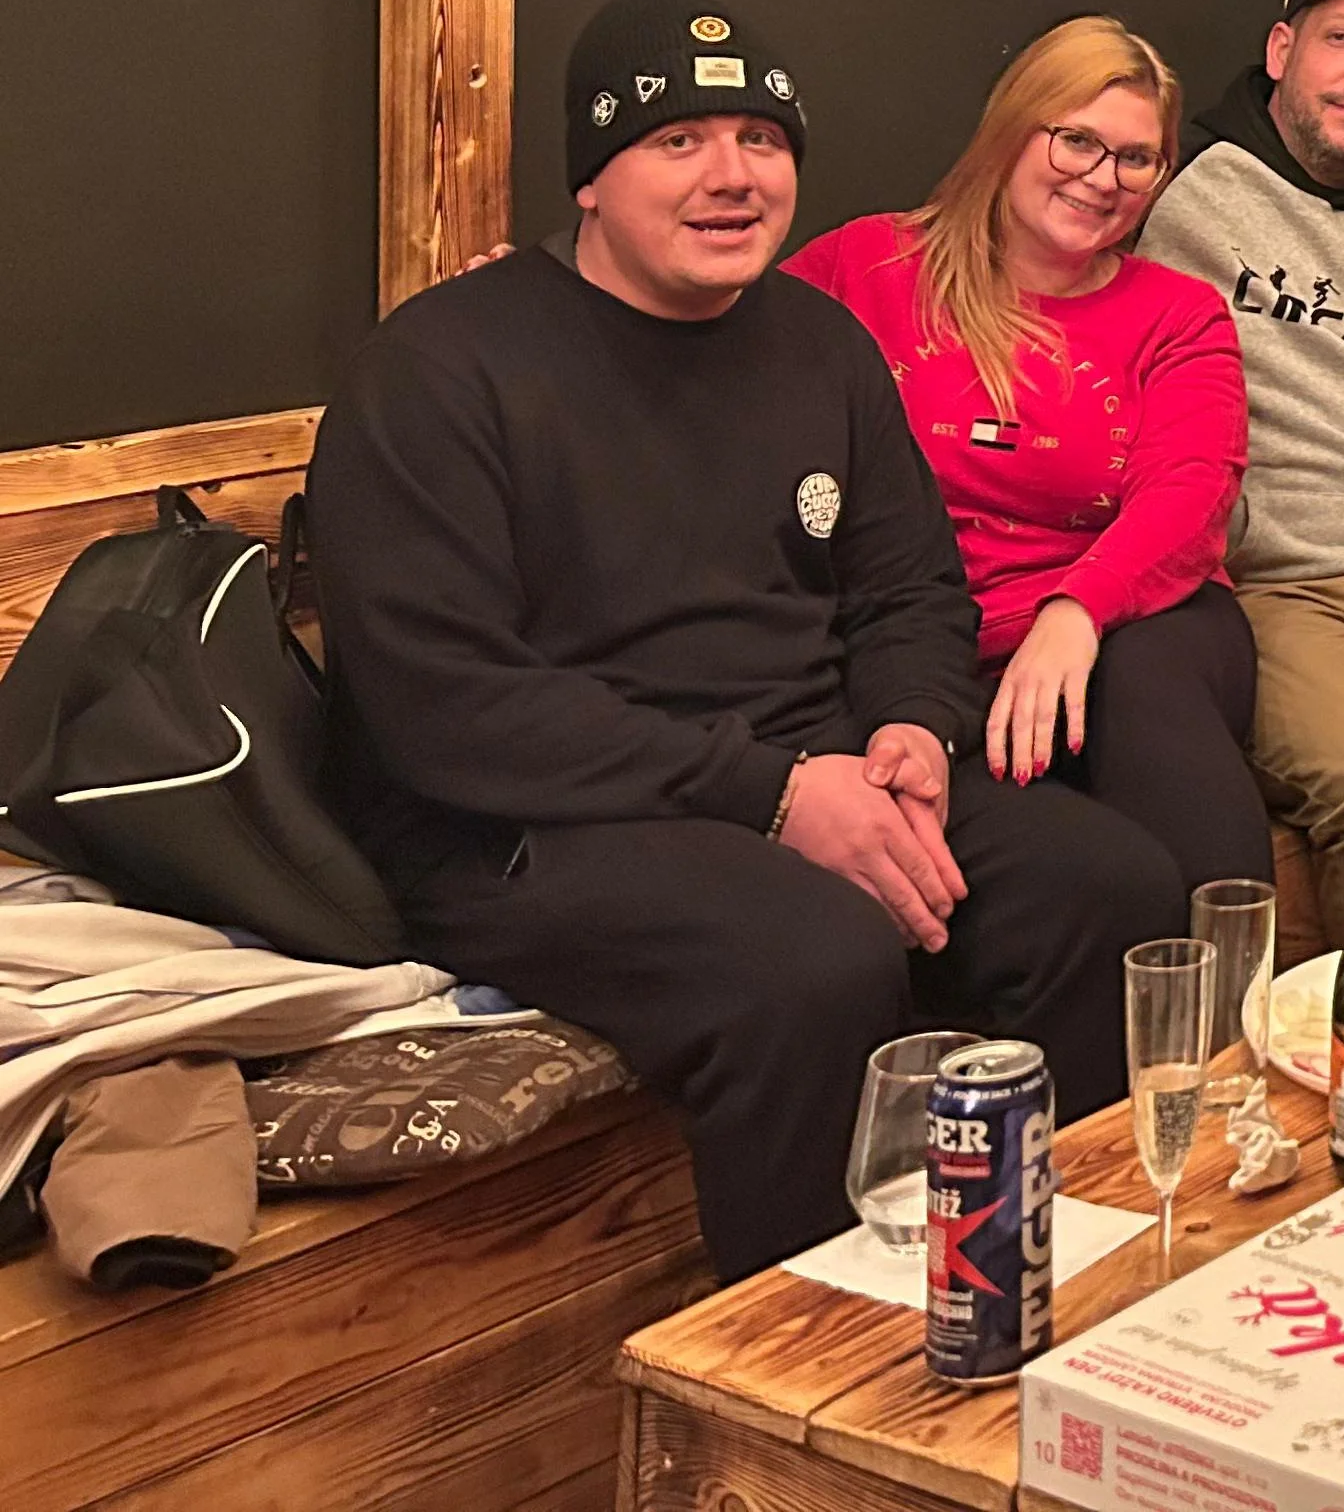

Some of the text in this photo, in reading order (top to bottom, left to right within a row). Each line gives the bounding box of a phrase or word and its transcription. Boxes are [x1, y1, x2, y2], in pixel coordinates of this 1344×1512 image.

[1030, 342, 1128, 470] ILFIGER
[500, 1043, 619, 1114] rela
[1021, 1110, 1057, 1351] TIGER
[1064, 1357, 1102, 1375] DEN
[1098, 1369, 1157, 1396] KAŽDÝ
[1157, 1391, 1247, 1428] OTEVŘENO
[1034, 1439, 1055, 1465] 10
